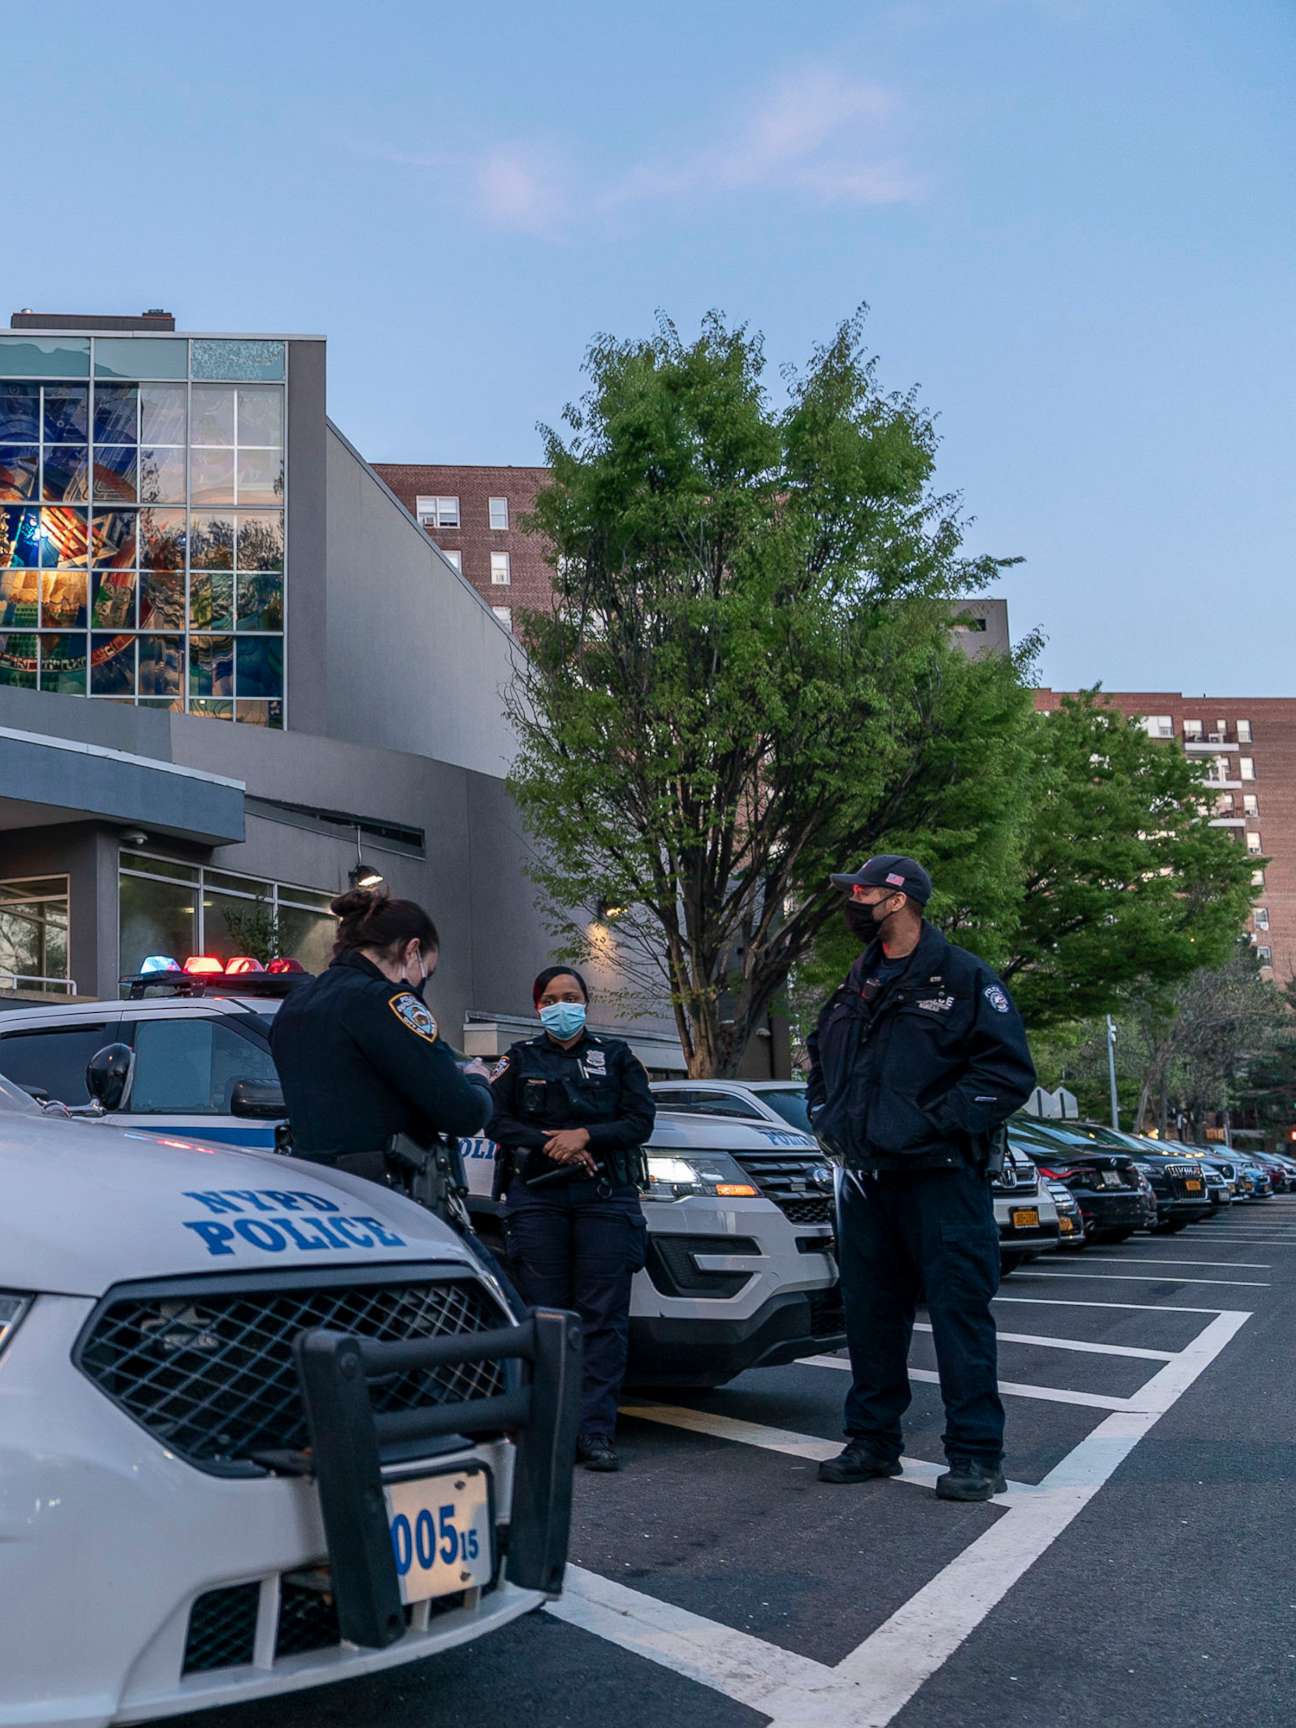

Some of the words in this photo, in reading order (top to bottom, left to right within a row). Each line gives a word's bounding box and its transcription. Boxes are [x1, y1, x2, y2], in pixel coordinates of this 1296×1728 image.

[458, 1137, 497, 1159] OLI
[181, 1190, 340, 1214] NYPD
[182, 1217, 407, 1256] POLICE
[391, 1504, 458, 1576] 005
[461, 1529, 479, 1561] 15
